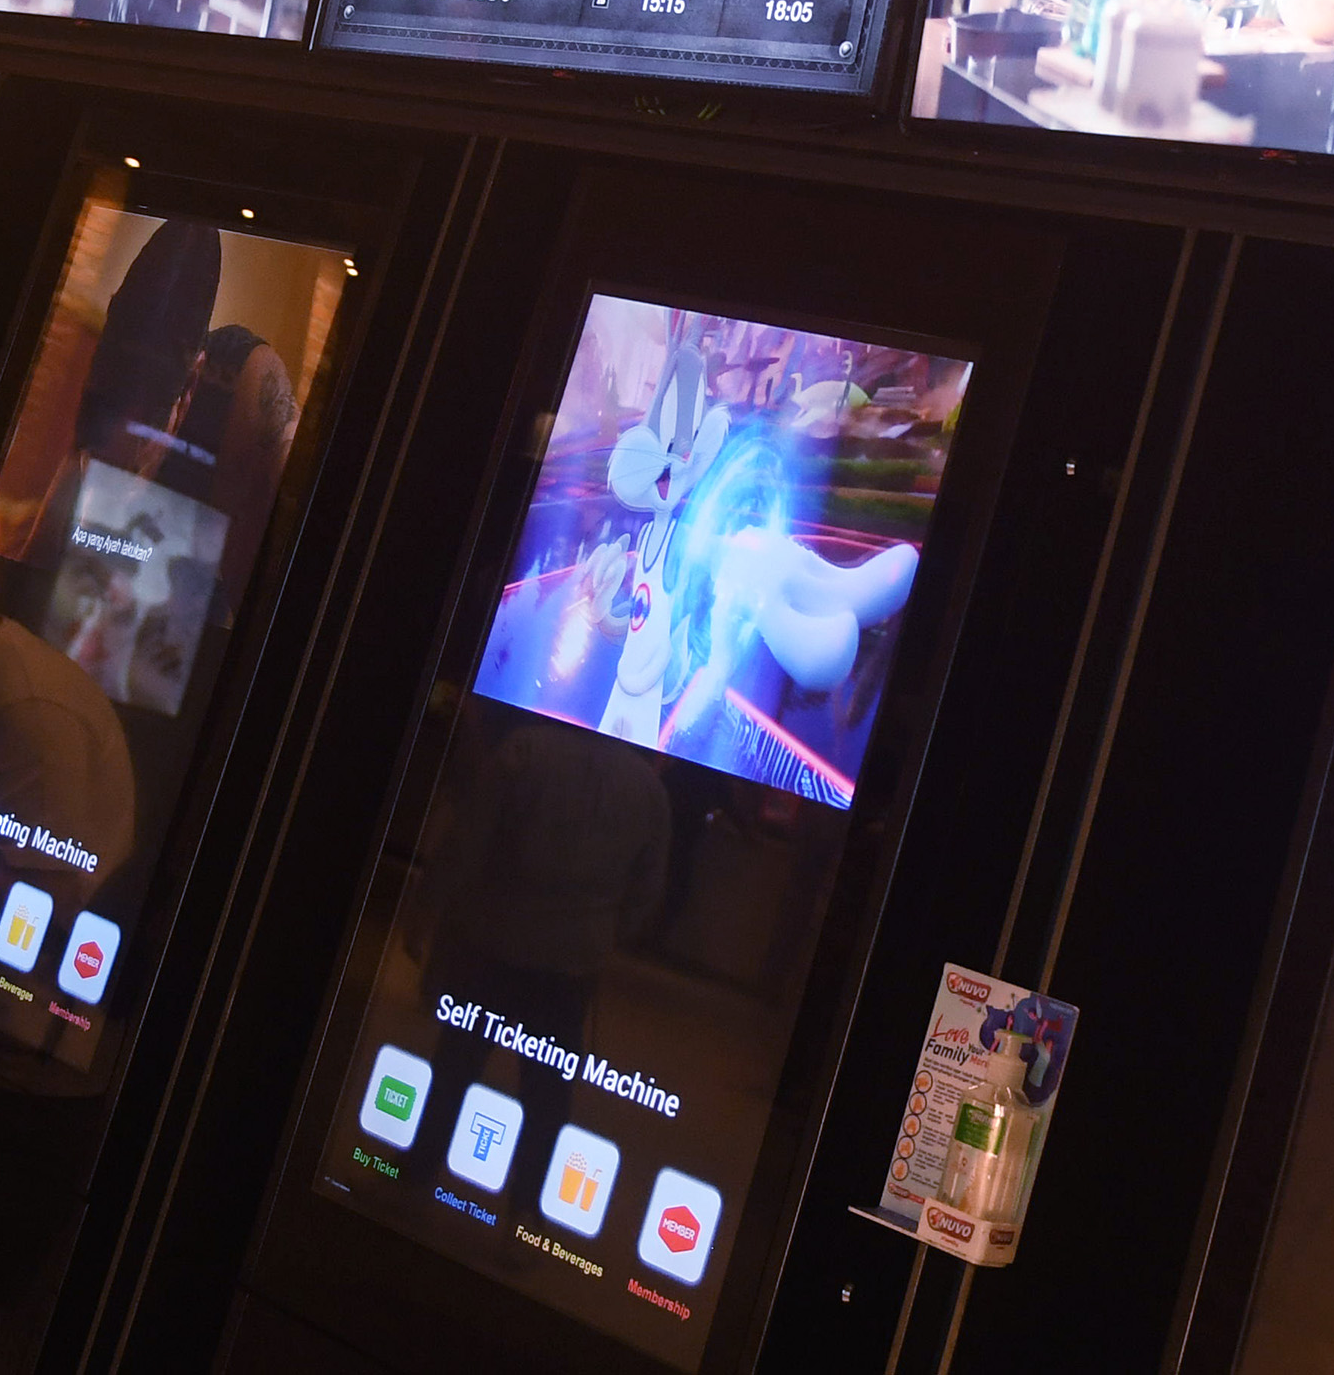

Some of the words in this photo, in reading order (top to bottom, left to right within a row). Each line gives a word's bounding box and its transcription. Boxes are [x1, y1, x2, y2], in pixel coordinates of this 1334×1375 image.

[765, 0, 814, 23] 18:05
[30, 825, 99, 874] Machine
[958, 979, 989, 1000] NUVO
[931, 1013, 970, 1045] Love
[436, 993, 483, 1033] Self
[483, 1010, 581, 1081] Ticketing
[581, 1053, 681, 1119] Machine
[925, 1038, 970, 1067] Family
[383, 1087, 409, 1110] TICKET
[352, 1146, 372, 1168] Buy
[371, 1155, 401, 1180] Ticket
[433, 1186, 468, 1213] Collect
[467, 1200, 498, 1228] Ticket
[661, 1216, 697, 1242] MEMBER
[940, 1215, 973, 1239] NUVO
[515, 1224, 542, 1249] Food
[541, 1237, 552, 1253] &
[550, 1240, 605, 1278] Beverages
[626, 1277, 692, 1322] Membership
